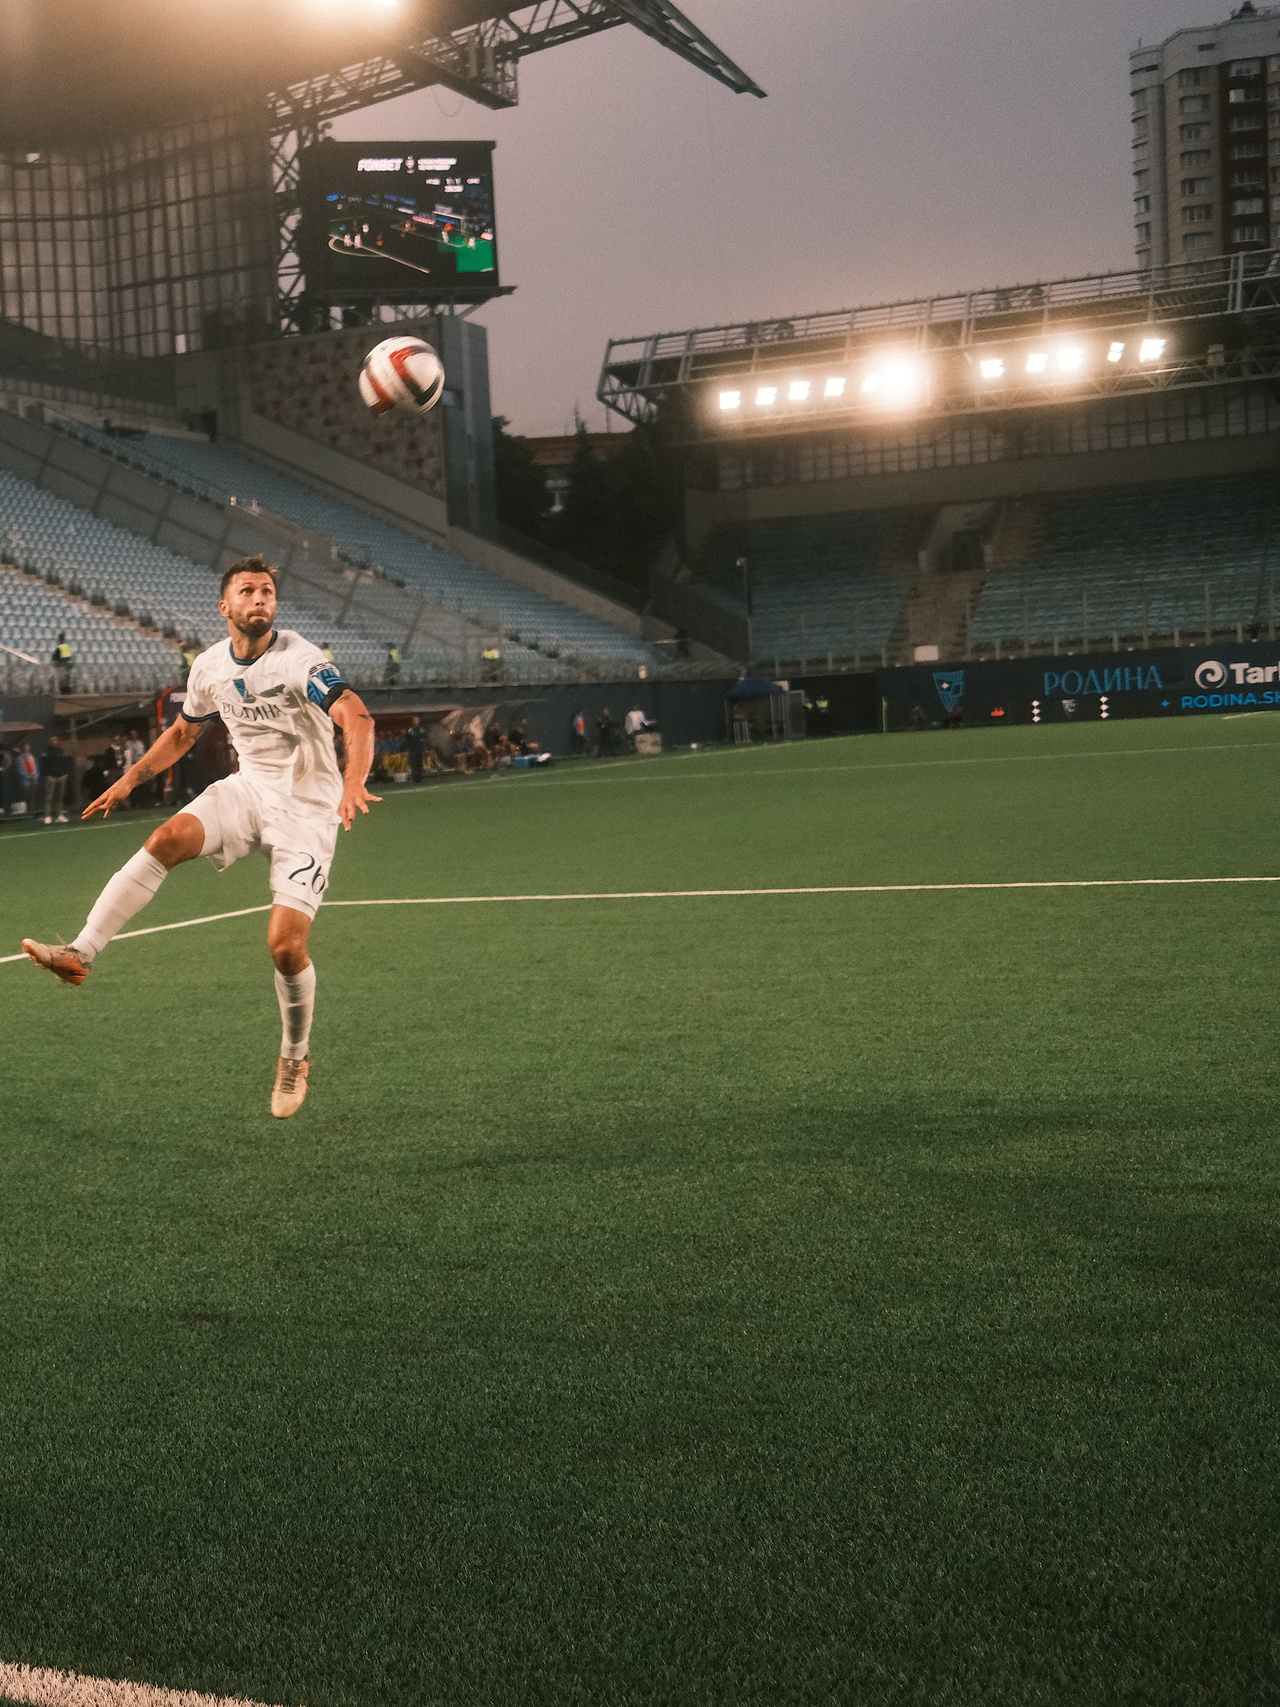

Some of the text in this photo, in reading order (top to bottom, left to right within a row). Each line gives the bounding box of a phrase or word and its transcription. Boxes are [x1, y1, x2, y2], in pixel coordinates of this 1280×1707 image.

[1044, 665, 1163, 695] РОДИНА
[1229, 661, 1280, 684] Tar
[288, 851, 326, 895] 26
